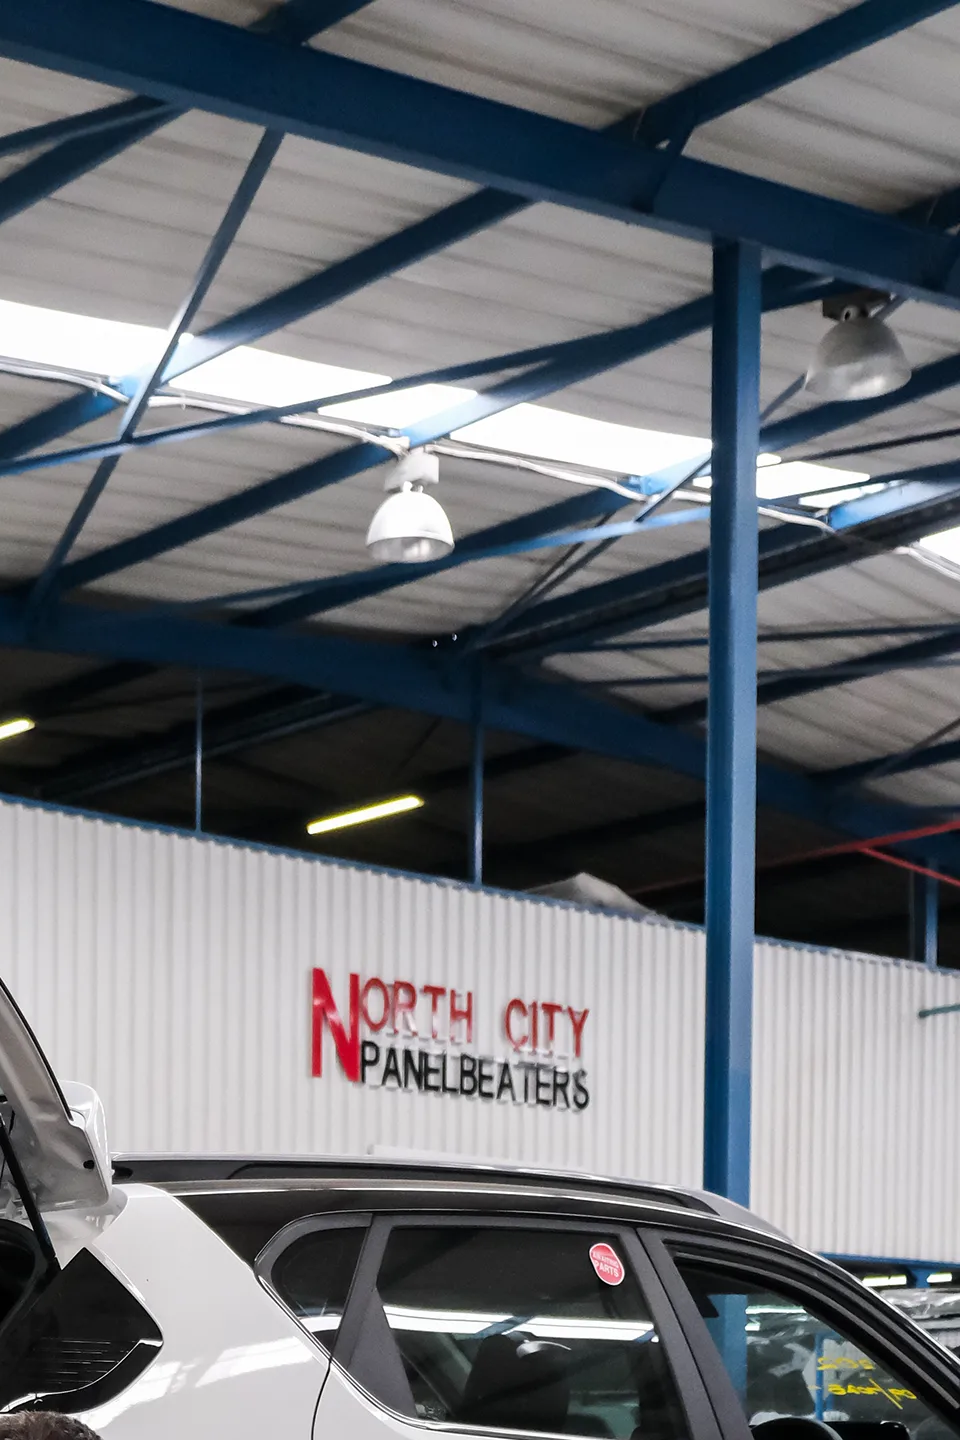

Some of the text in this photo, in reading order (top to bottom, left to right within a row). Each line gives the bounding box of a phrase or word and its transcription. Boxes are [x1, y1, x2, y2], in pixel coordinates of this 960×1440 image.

[311, 967, 590, 1083] NORTH CITY
[360, 1040, 590, 1110] PANELBEATERS
[594, 1259, 620, 1278] PARTS
